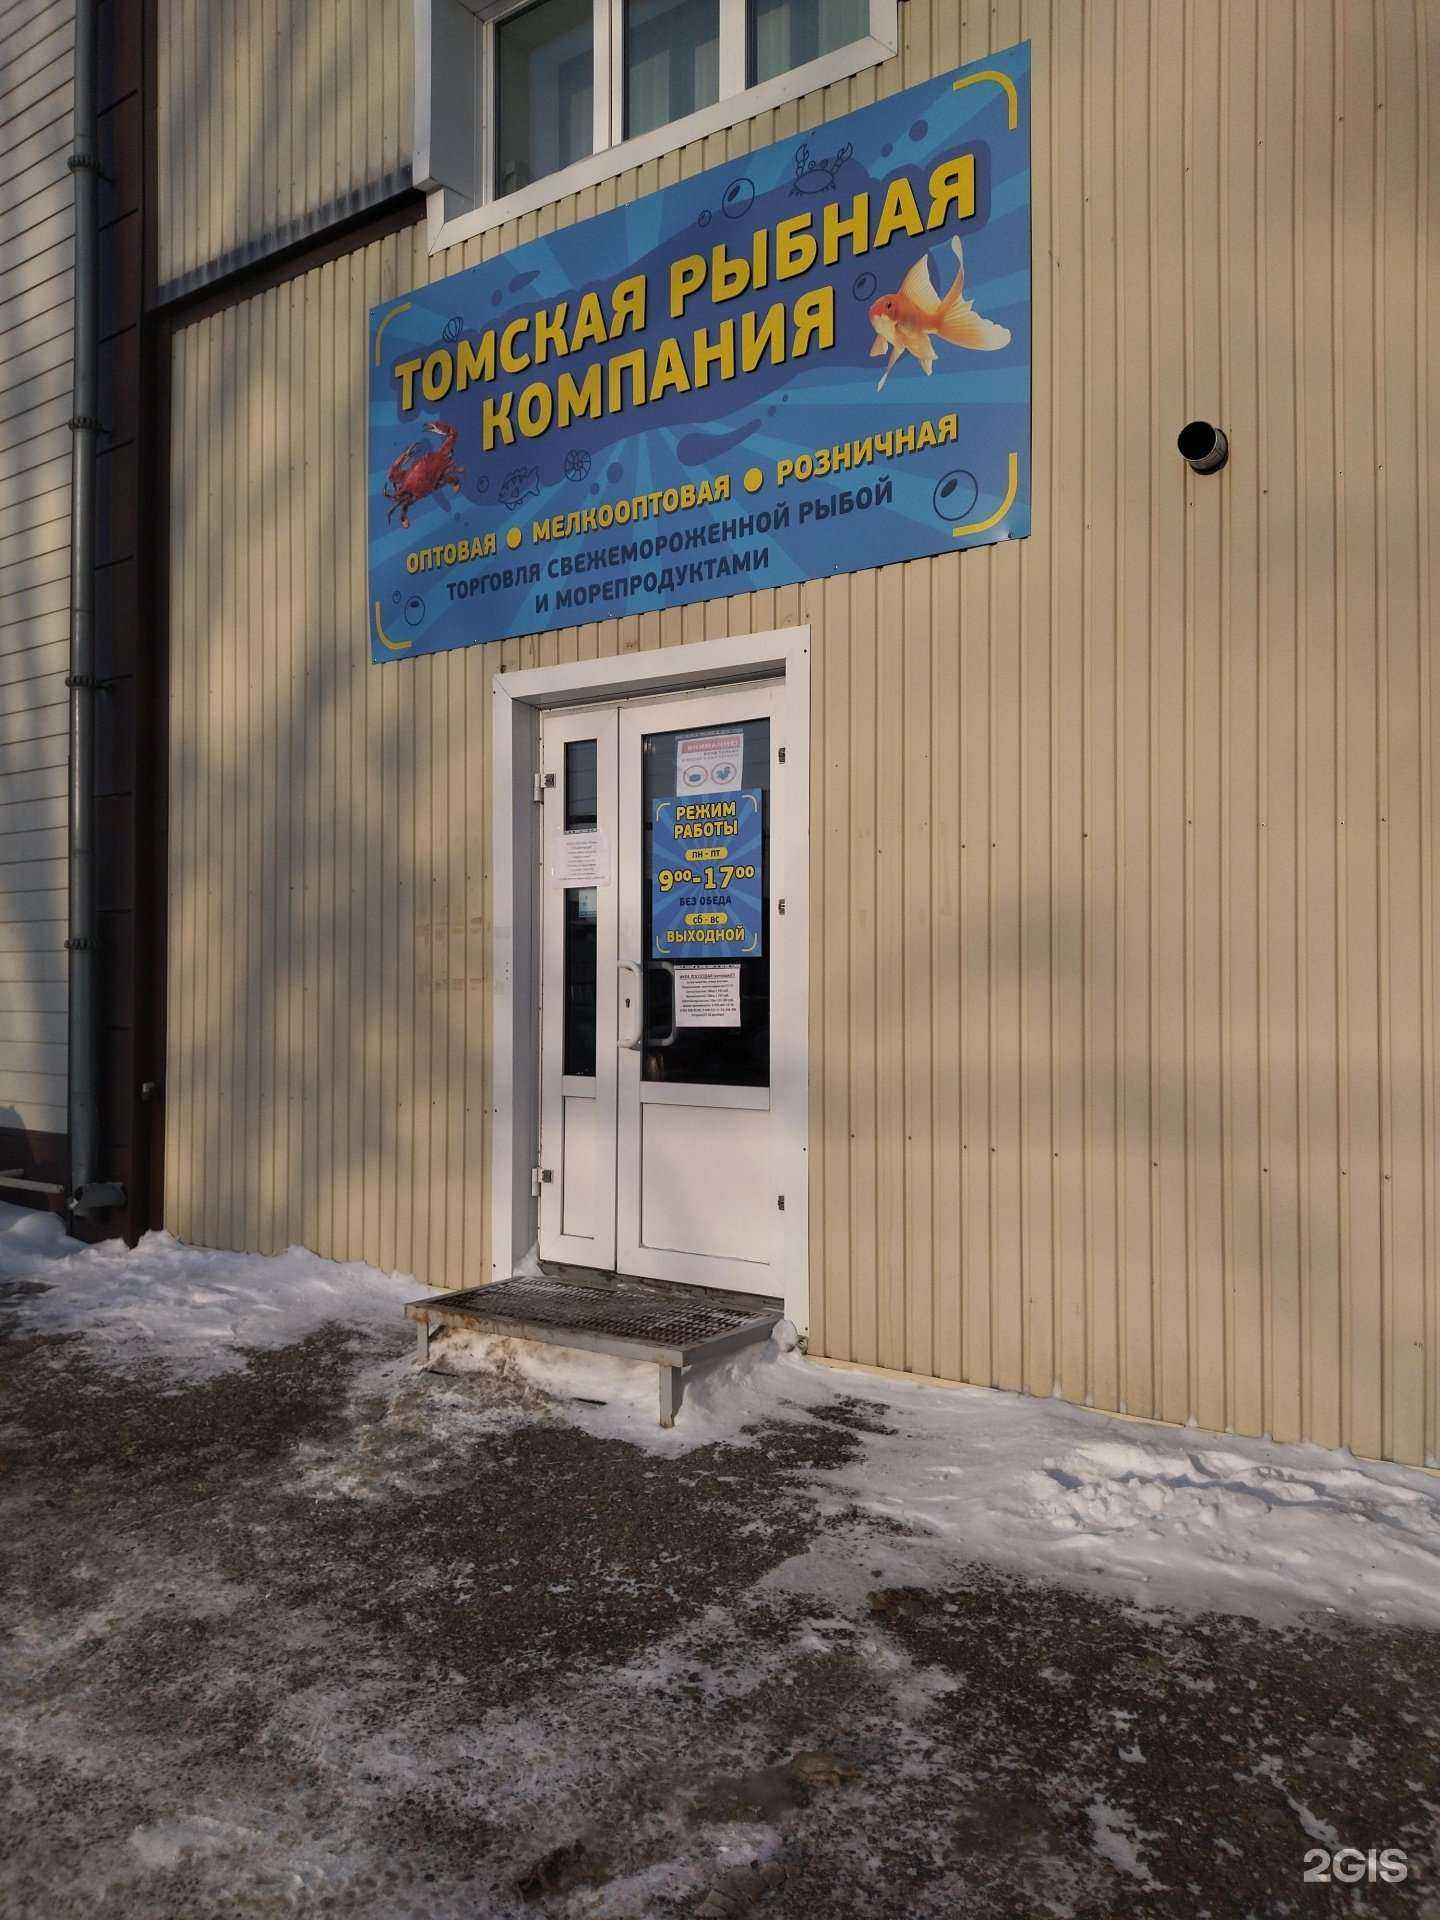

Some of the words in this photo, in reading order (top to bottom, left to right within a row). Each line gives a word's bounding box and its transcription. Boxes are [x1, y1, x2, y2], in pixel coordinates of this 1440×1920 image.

[394, 275, 646, 410] ТОМСКАЯ
[669, 154, 976, 317] РЫБНАЯ
[482, 287, 835, 452] КОМПАНИЯ
[406, 533, 497, 574] ОПТОВАЯ
[532, 475, 731, 544] МЕЛКООПТОВАЯ
[777, 413, 958, 485] РОЗНИЧНАЯ
[446, 563, 541, 601] ТОРГОВЛЯ
[547, 501, 791, 579] СВЕЖЕМОРОЖЕННОЙ
[799, 474, 894, 524] РЫБОЙ
[535, 593, 549, 613] И
[555, 547, 770, 611] МОРЕПРОДУКТАМИ
[674, 820, 738, 839] РАБОТЫ
[676, 802, 736, 821] РЕЖИМ
[680, 897, 697, 906] БЕЗ
[700, 895, 732, 906] ОБЕДА
[666, 925, 745, 944] ВЫХОДНОЙ
